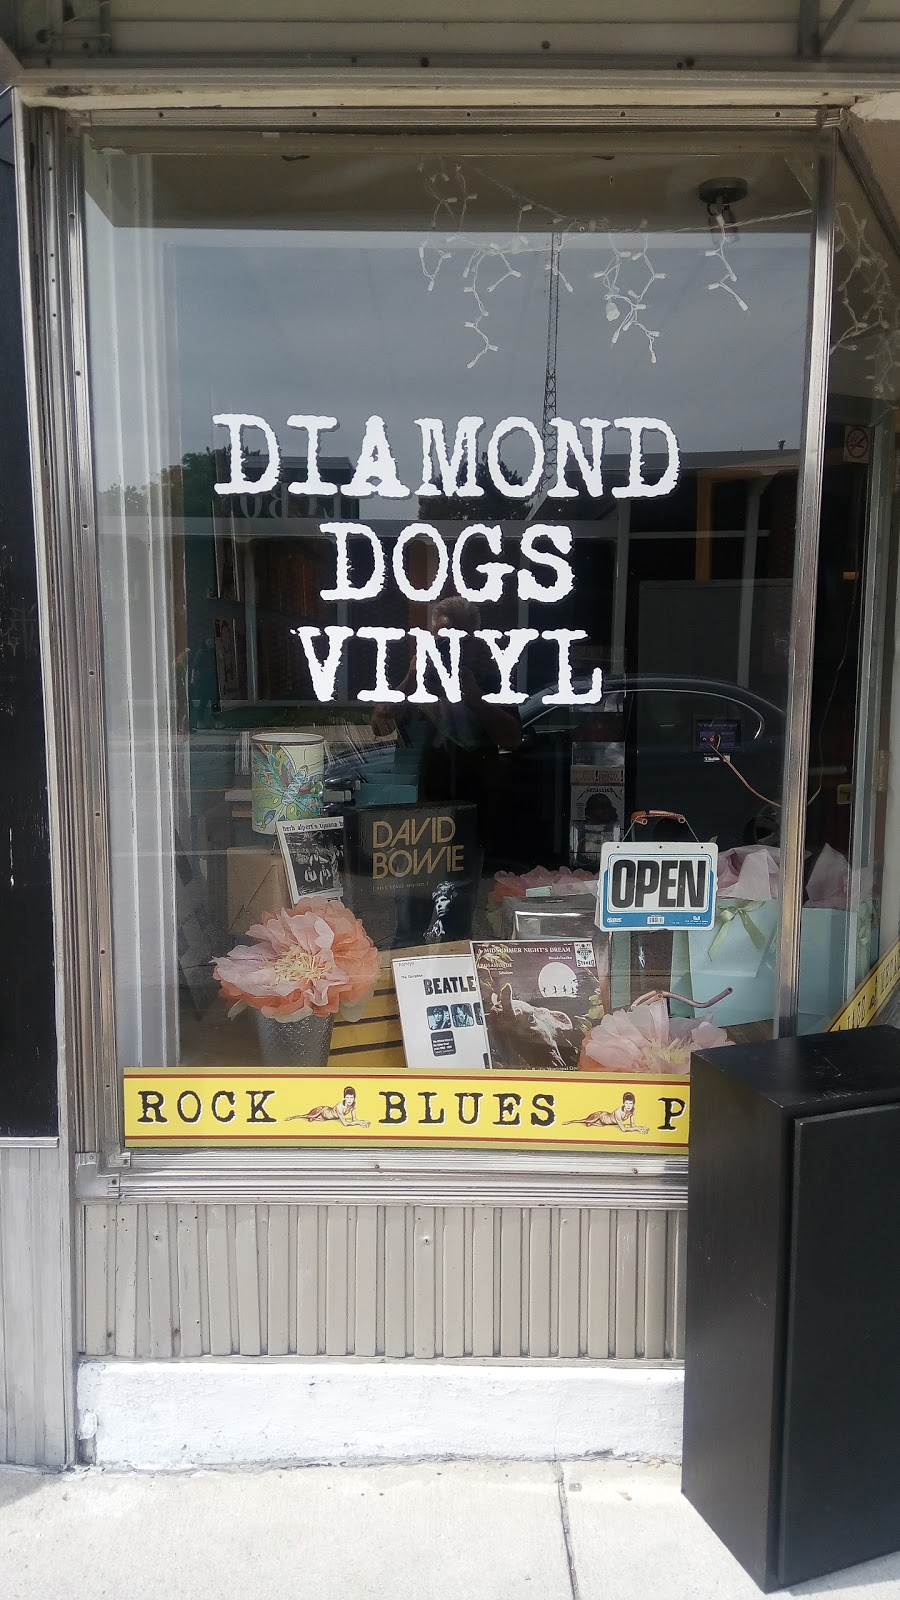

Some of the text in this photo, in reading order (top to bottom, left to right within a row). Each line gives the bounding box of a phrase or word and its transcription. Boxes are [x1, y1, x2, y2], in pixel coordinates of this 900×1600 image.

[212, 413, 681, 498] DIAMOND
[319, 522, 577, 603] DOGS
[290, 625, 603, 705] VINYL
[372, 816, 456, 849] DAVID
[372, 845, 464, 880] BOWIE
[611, 858, 706, 910] OPEN
[137, 1089, 278, 1126] ROCK
[378, 1090, 557, 1127] BLUES
